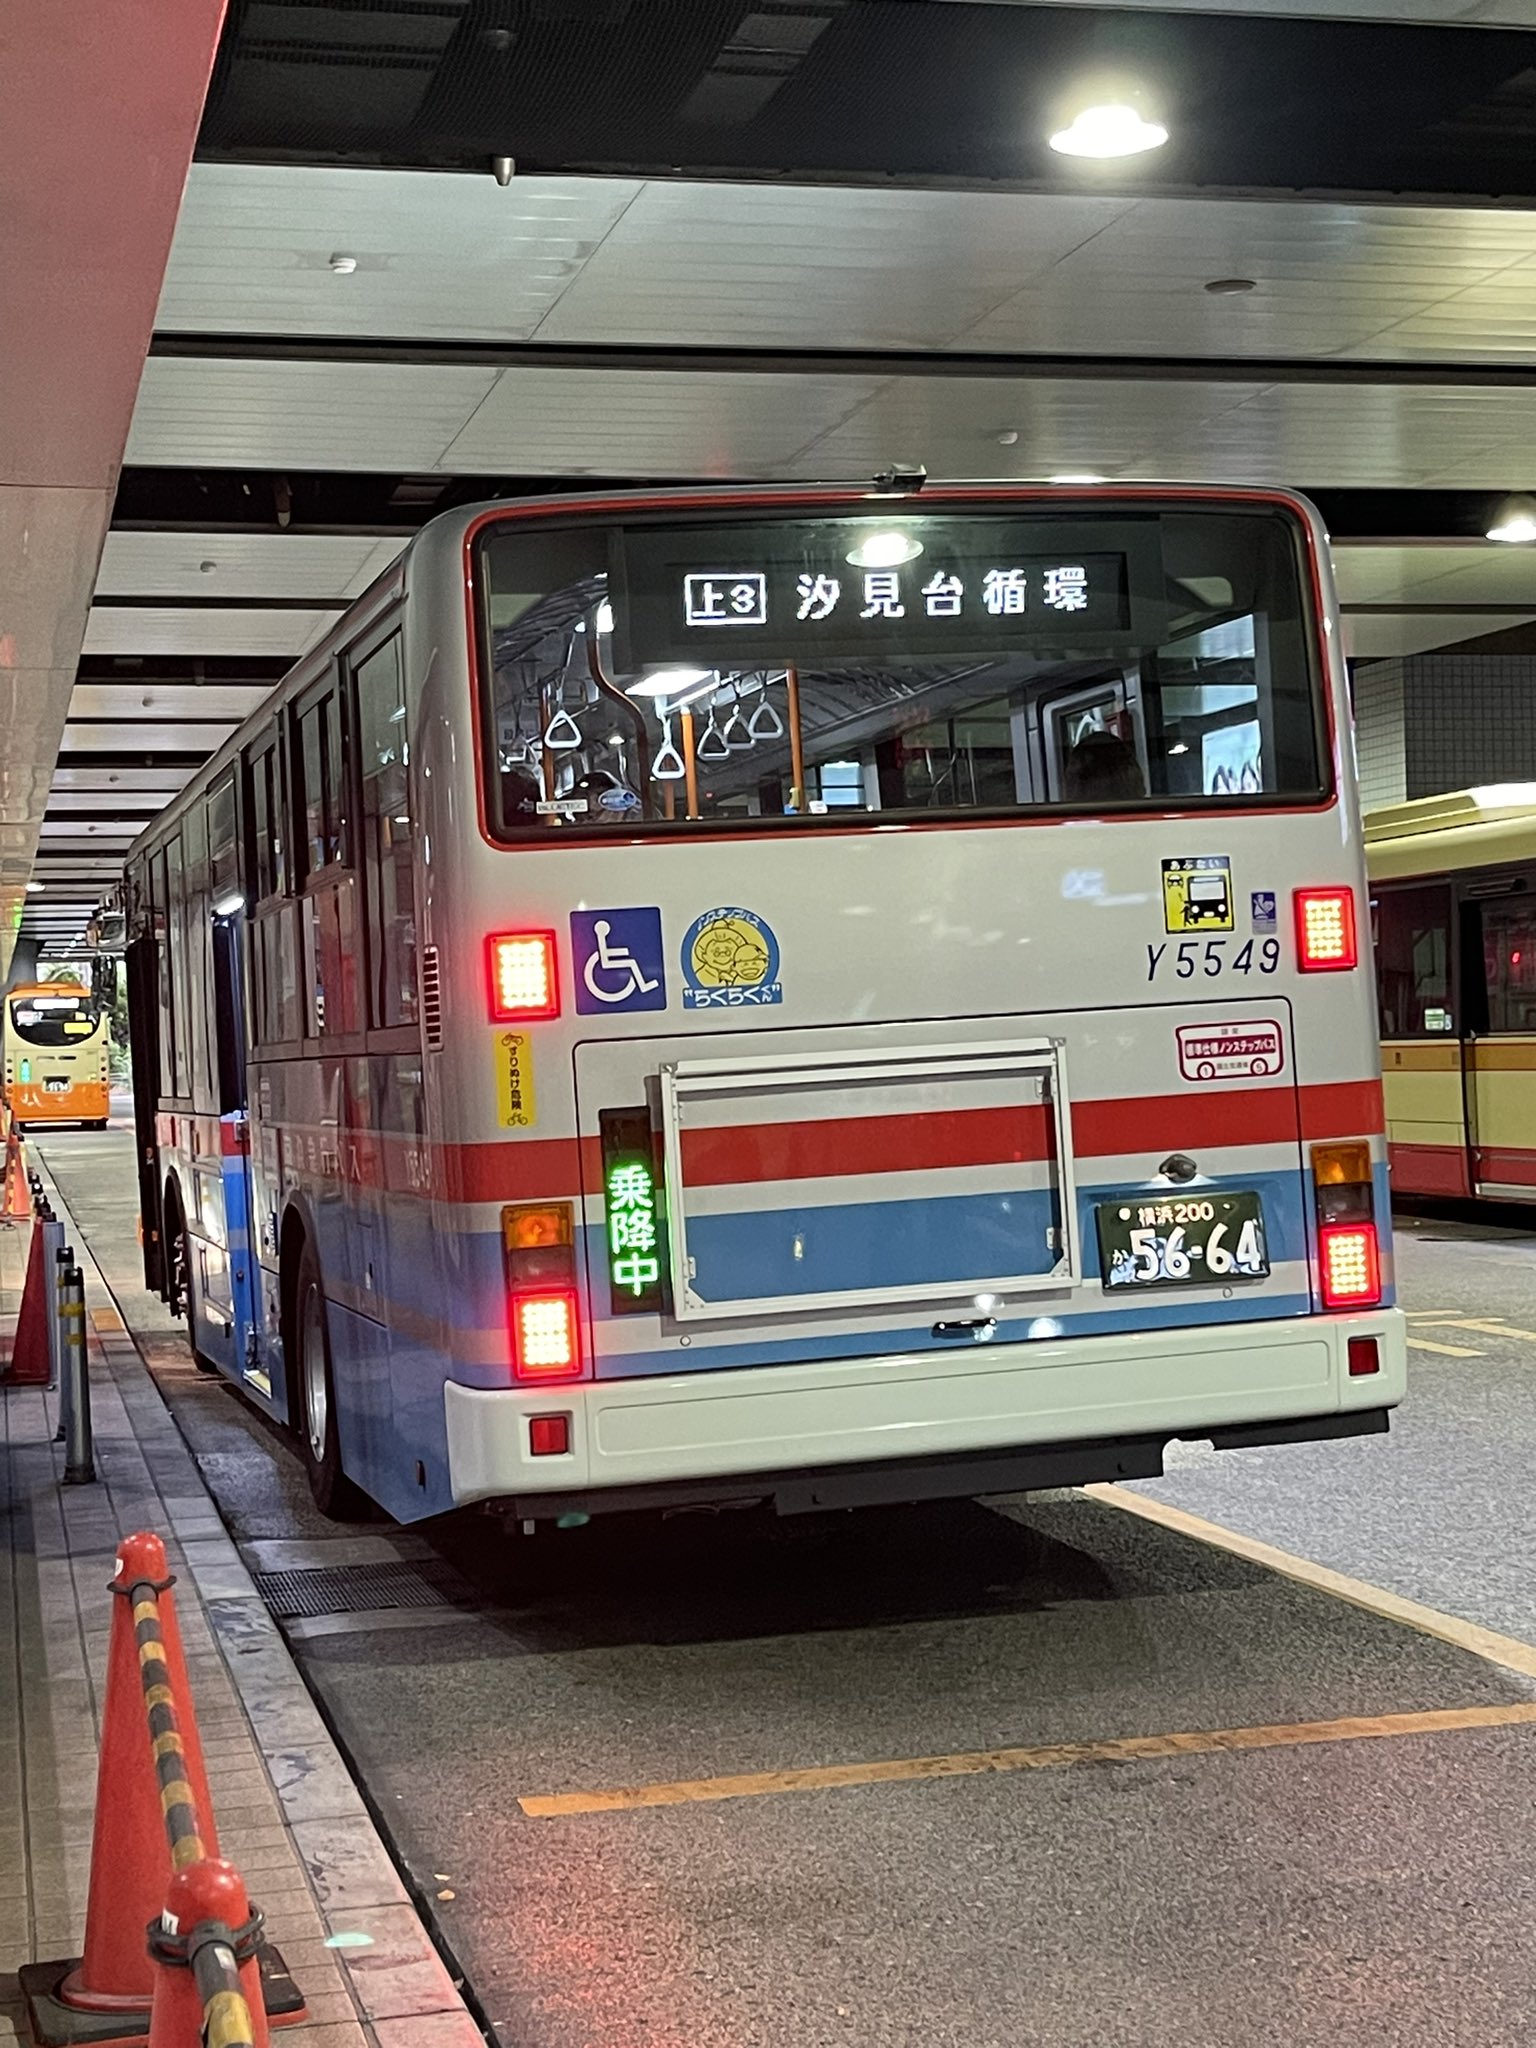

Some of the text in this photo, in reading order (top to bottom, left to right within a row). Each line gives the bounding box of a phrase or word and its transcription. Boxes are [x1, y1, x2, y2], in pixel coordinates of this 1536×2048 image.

[691, 567, 1088, 620] 上3 汐見台循環
[1170, 859, 1221, 871] あぶない
[1147, 938, 1280, 981] Y5549
[608, 1164, 658, 1297] 乗降中
[1130, 1219, 1261, 1280] 56-64
